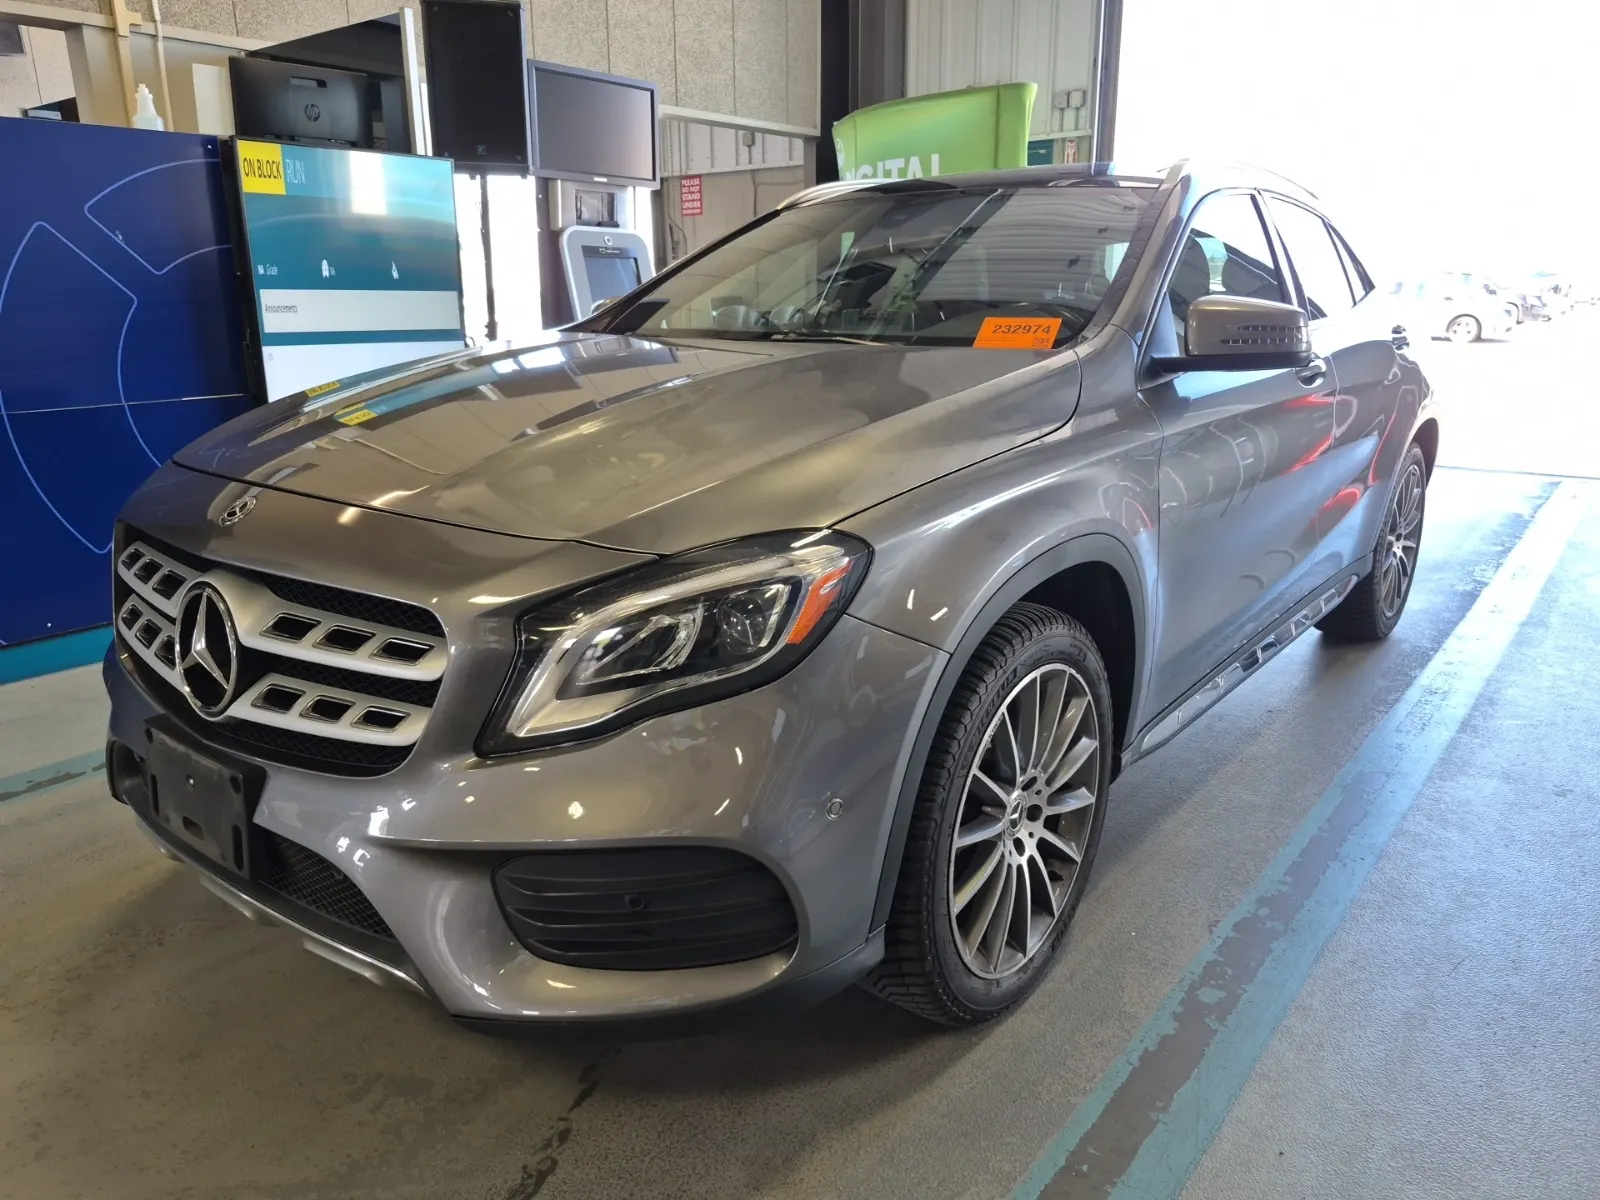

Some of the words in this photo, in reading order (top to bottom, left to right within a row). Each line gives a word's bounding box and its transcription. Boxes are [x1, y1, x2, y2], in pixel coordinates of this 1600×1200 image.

[304, 104, 320, 121] hp
[243, 157, 256, 178] ON
[257, 158, 282, 179] BLOCK
[286, 159, 306, 184] RUN
[682, 178, 700, 186] PLEASE
[682, 193, 700, 201] STAND
[991, 324, 1053, 335] 232974
